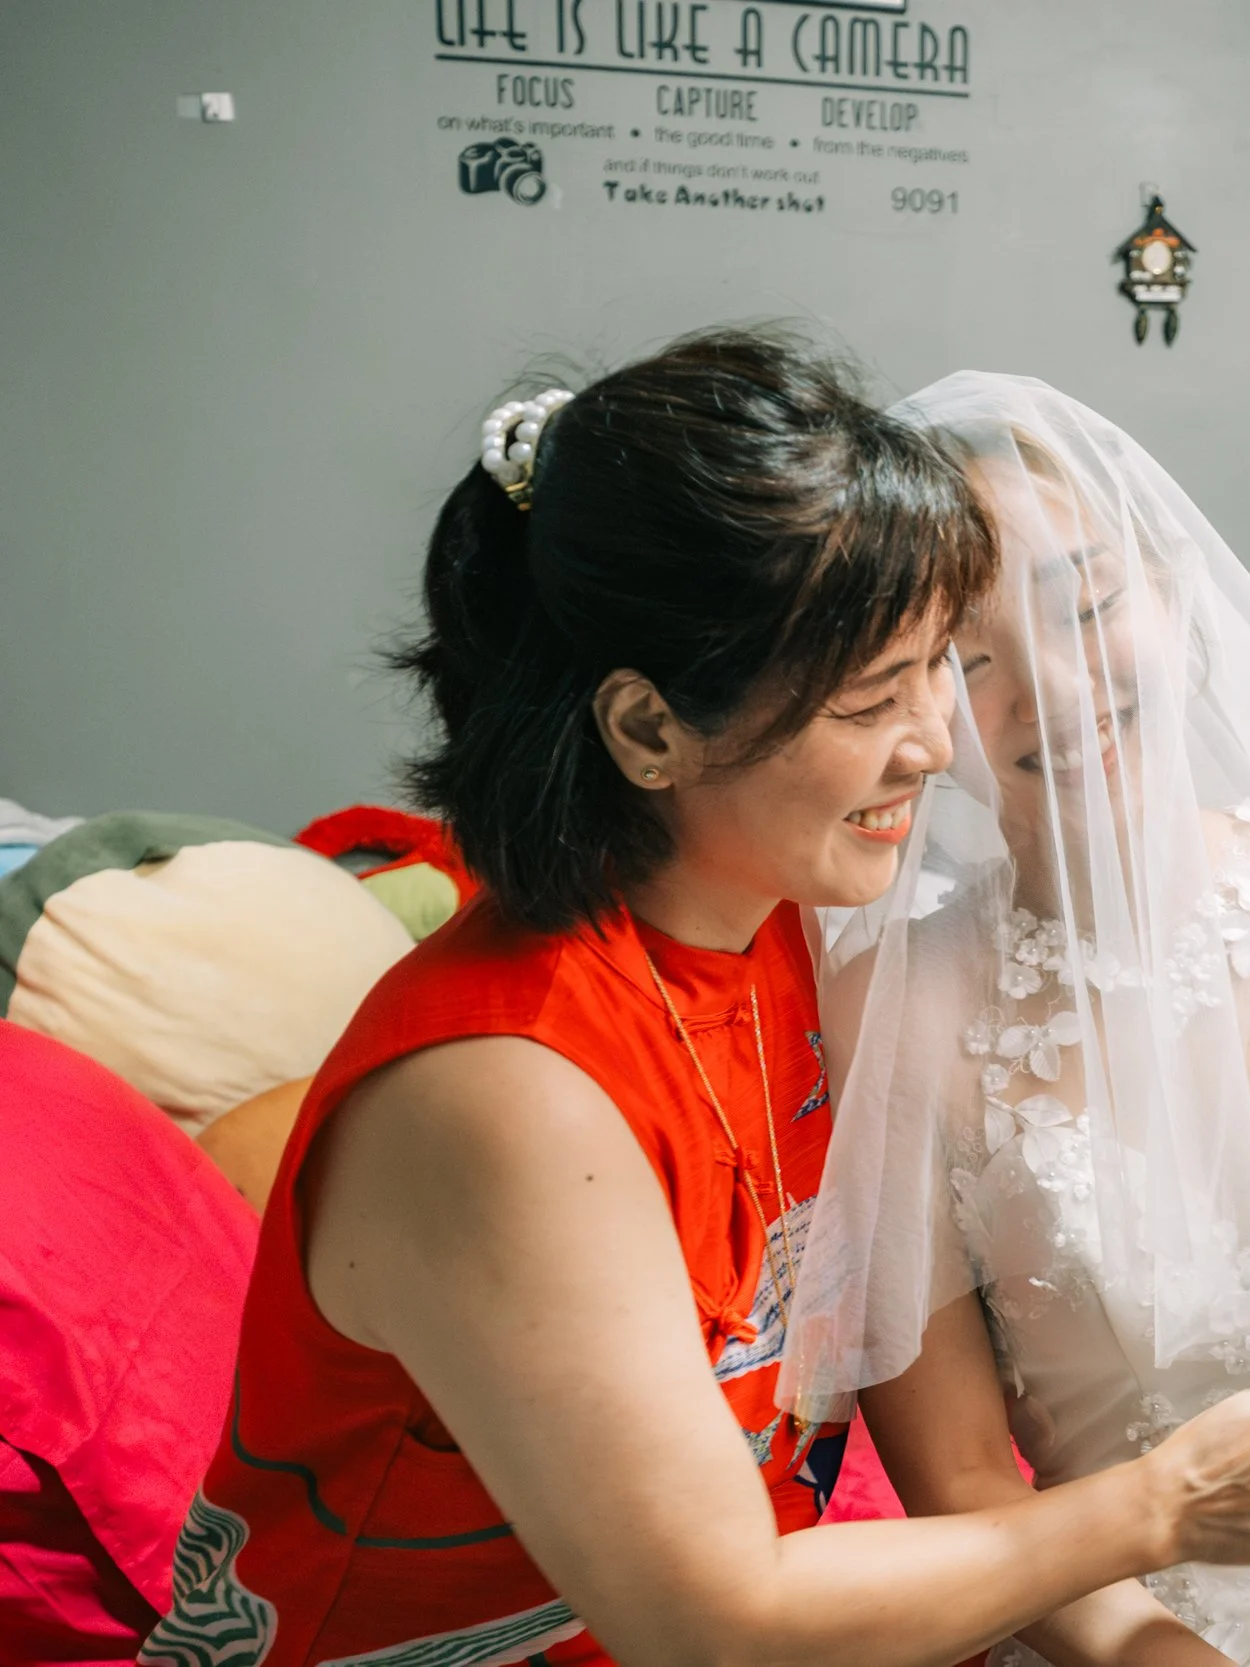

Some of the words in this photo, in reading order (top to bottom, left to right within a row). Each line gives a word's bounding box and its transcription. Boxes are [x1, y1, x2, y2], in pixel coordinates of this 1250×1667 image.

[436, 0, 528, 51] LIFE
[556, 0, 586, 55] IS
[616, 0, 710, 64] LIKE
[733, 6, 763, 69] A
[791, 13, 970, 84] CAMERA
[496, 73, 576, 110] FOCUS
[655, 84, 758, 122] CAPTURE
[821, 96, 919, 132] DEVELOP
[437, 115, 459, 132] on
[466, 114, 524, 134] what's
[528, 118, 616, 141] important
[653, 125, 682, 145] the
[686, 129, 732, 150] good
[736, 132, 775, 151] time
[812, 135, 853, 154] from
[856, 138, 884, 158] the
[886, 143, 970, 168] negatives
[602, 158, 635, 174] and
[639, 158, 651, 174] if
[653, 160, 704, 180] things
[707, 163, 749, 179] don't
[751, 166, 790, 183] work
[793, 171, 820, 185] out
[602, 179, 669, 205] Take
[674, 184, 770, 211] Another
[776, 191, 827, 214] shot
[890, 185, 960, 214] 9091
